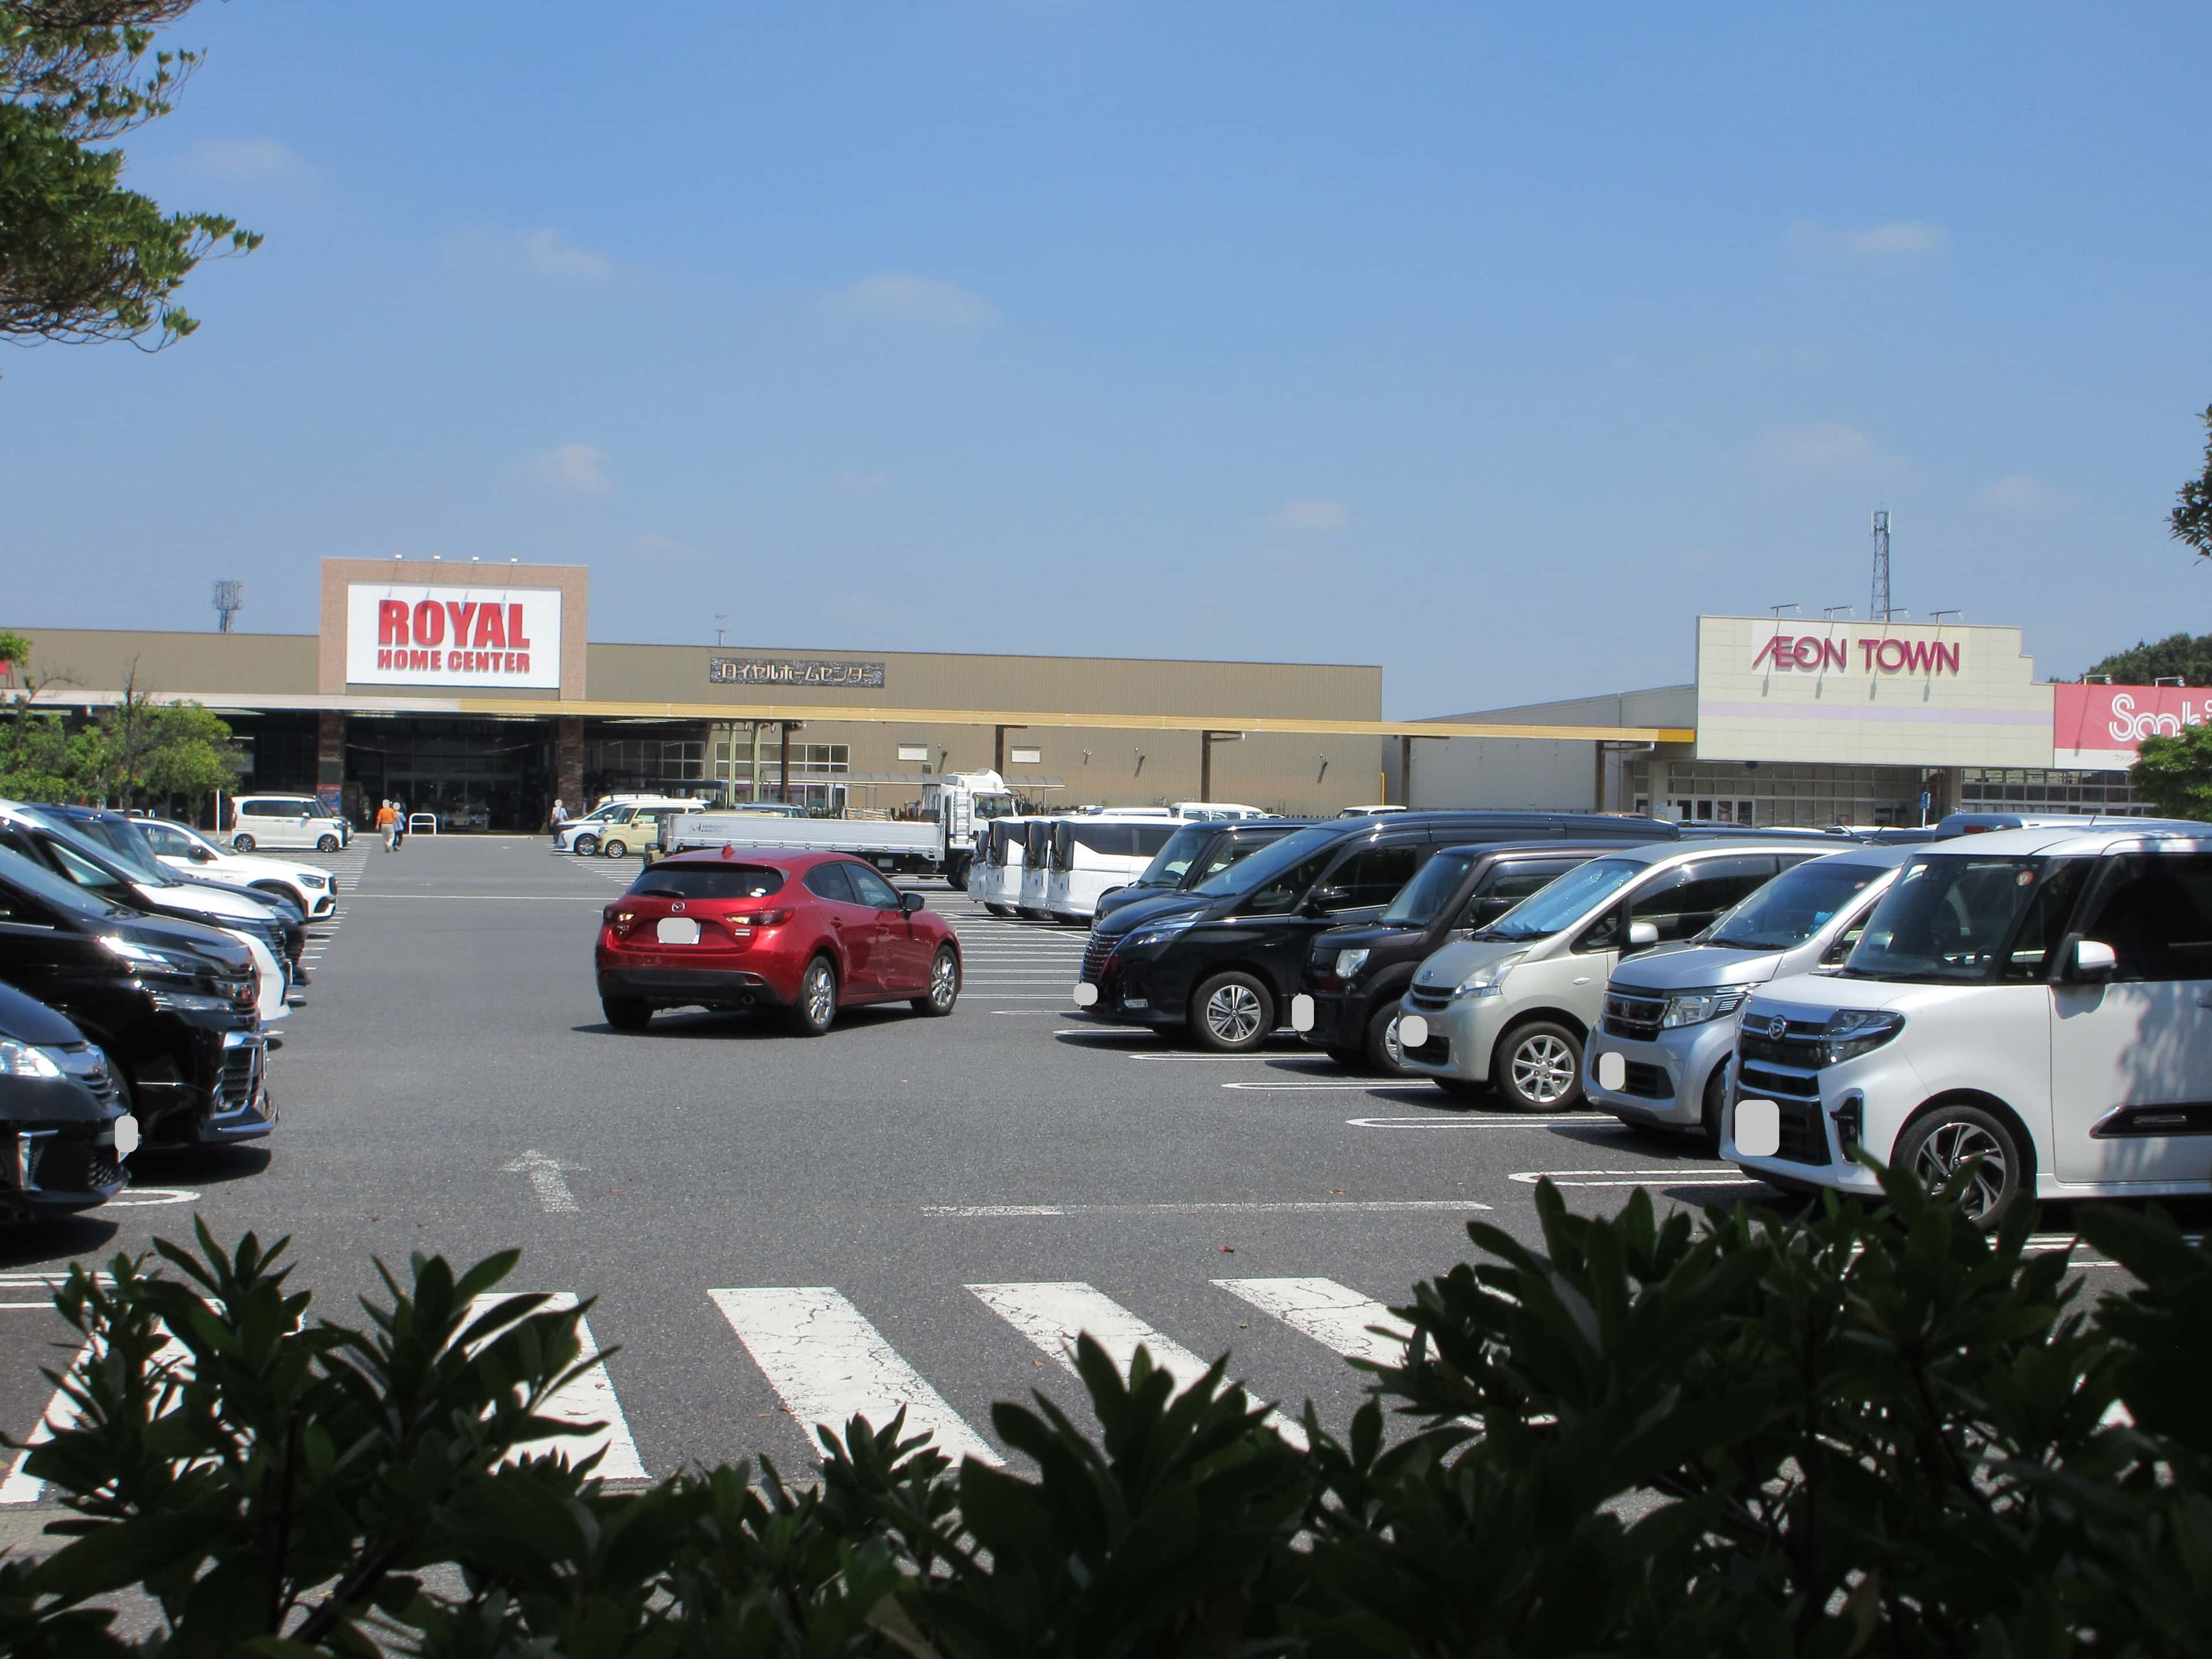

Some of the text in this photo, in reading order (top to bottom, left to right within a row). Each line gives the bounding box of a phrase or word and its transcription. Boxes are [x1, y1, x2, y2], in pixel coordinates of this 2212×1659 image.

[378, 600, 530, 649] ROYAL
[378, 649, 530, 673] HOME CENTER
[721, 662, 874, 682] ロイヤルホームセンター
[1859, 639, 1959, 672] TOWN
[2108, 692, 2212, 742] Sank
